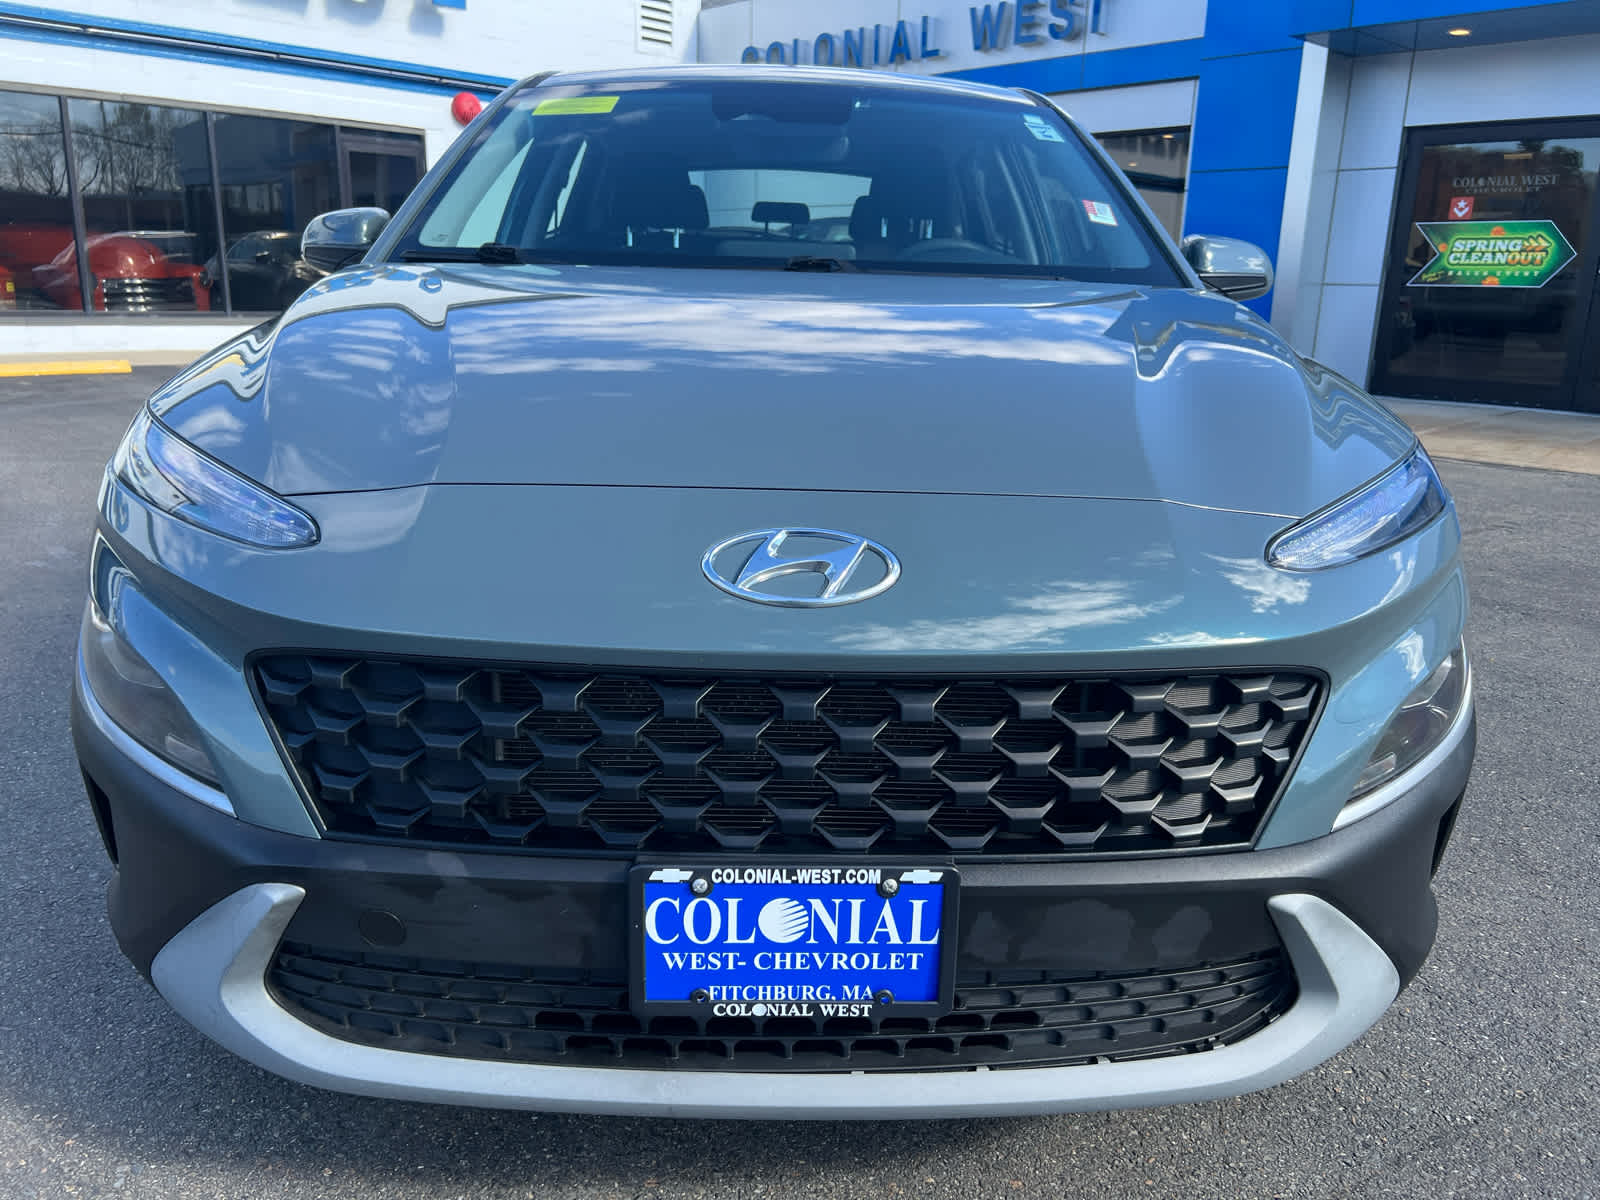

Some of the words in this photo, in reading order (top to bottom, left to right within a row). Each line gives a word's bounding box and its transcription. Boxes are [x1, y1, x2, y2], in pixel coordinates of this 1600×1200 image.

[1452, 175, 1517, 188] COLONIAL
[1521, 174, 1560, 185] WEST
[1452, 239, 1523, 252] SPRING
[1448, 251, 1547, 265] CLEANOUT
[711, 868, 881, 885] COLONIAL-WEST.COM
[645, 897, 940, 945] COLONIAL
[753, 951, 924, 971] CHEVROLET
[708, 984, 837, 1001] FITCHBURG,
[841, 984, 875, 1001] MA
[712, 1003, 814, 1017] COLONIAL
[819, 1003, 873, 1017] WEST
